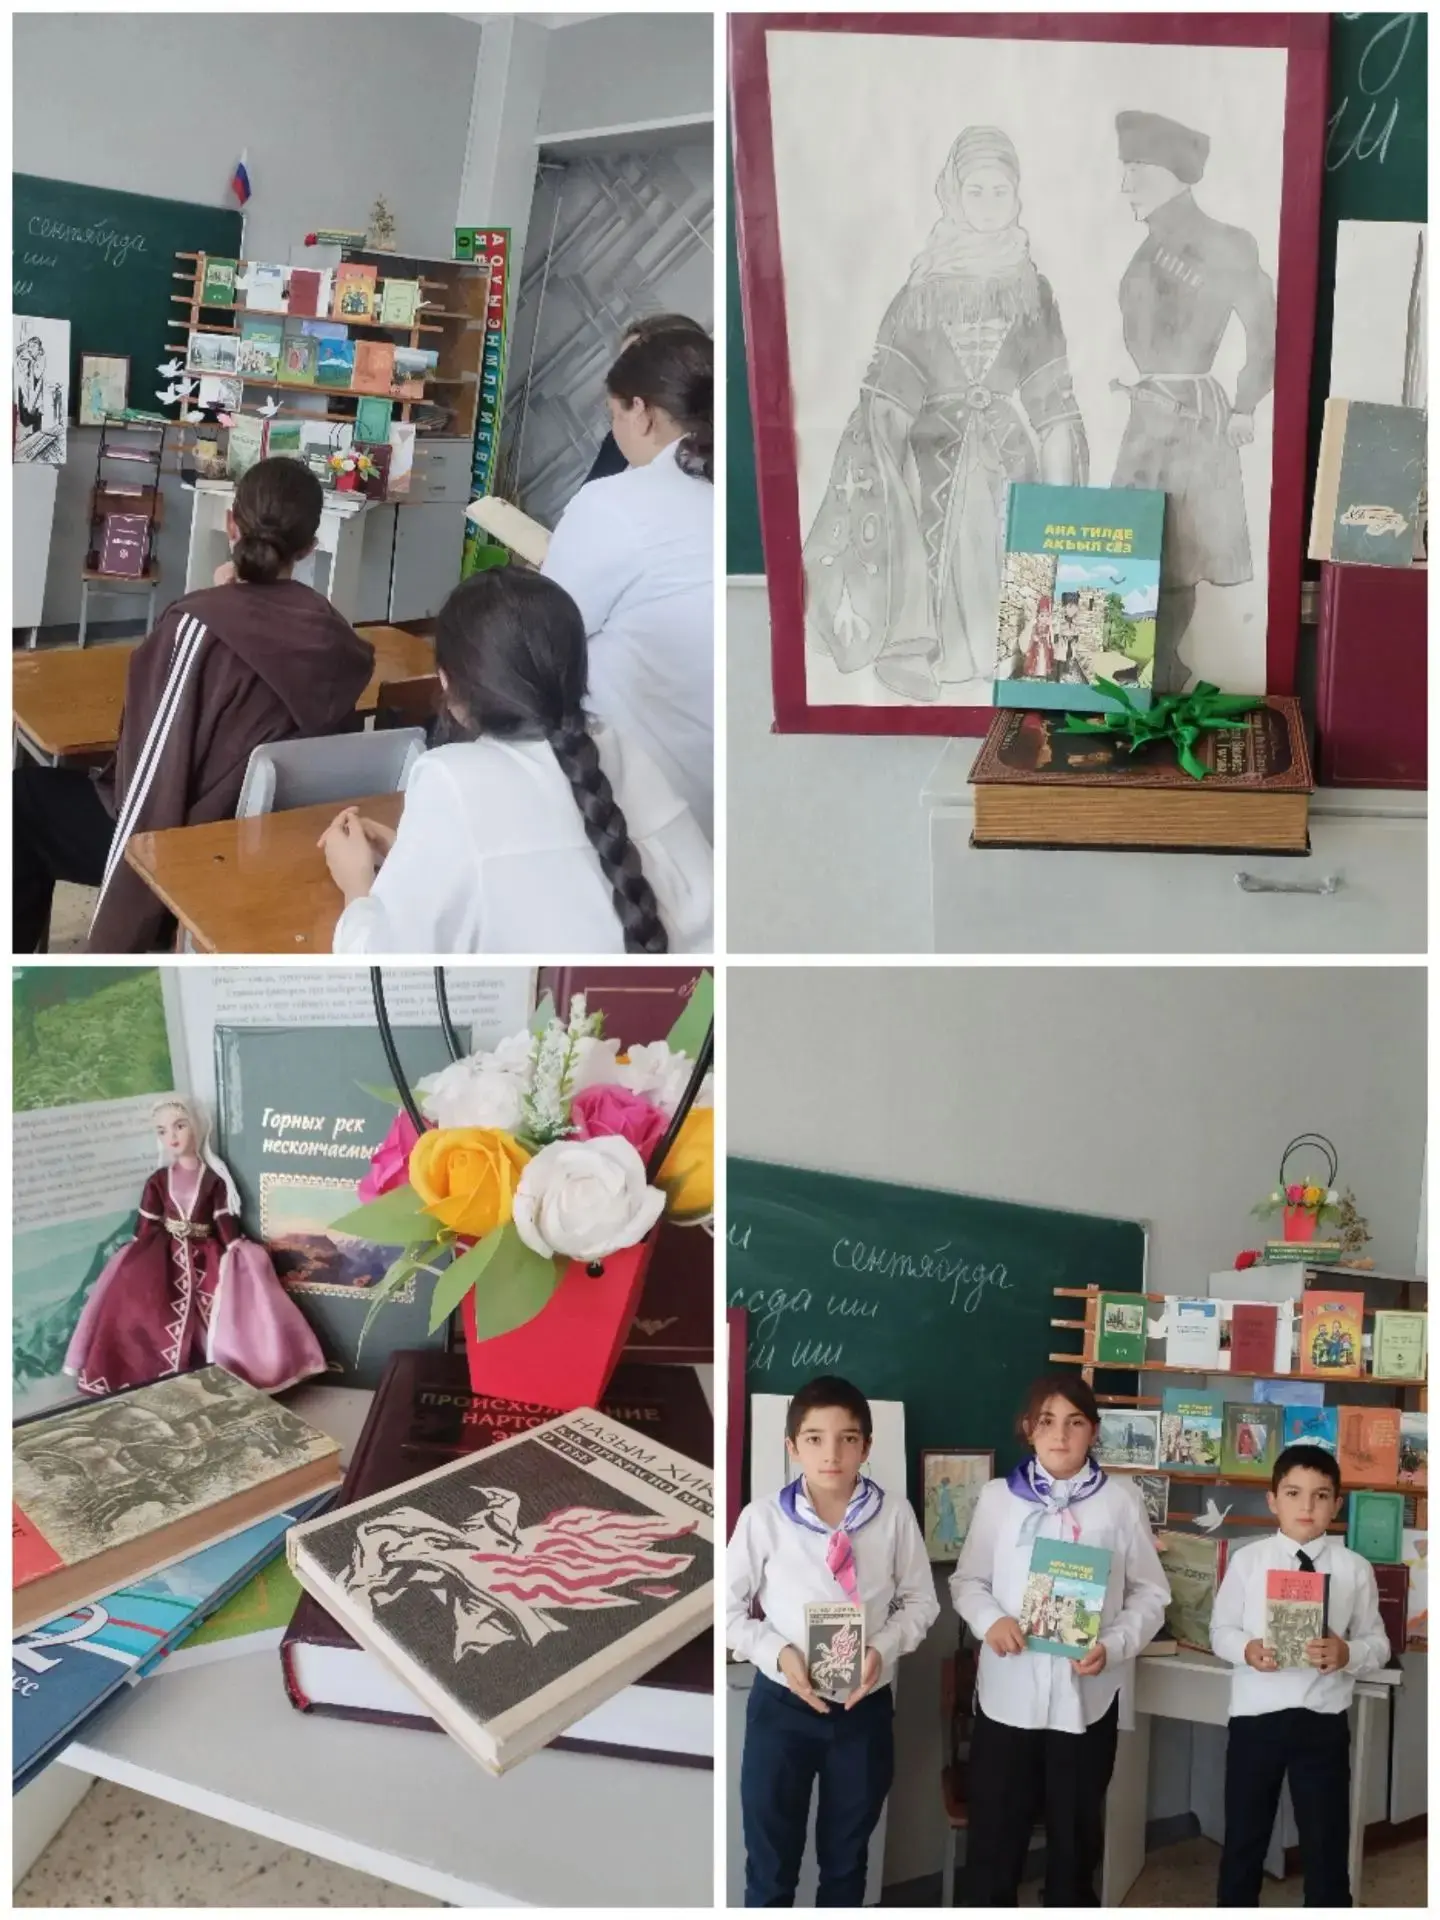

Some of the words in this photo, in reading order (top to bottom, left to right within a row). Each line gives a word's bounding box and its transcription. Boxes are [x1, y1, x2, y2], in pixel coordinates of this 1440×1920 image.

[1043, 523, 1077, 537] АНА
[1080, 526, 1134, 541] ТИЛДЕ
[261, 1107, 325, 1137] Горных
[331, 1117, 366, 1140] рек
[262, 1137, 384, 1160] нескончаемы
[571, 1417, 657, 1464] НАЗЫМ
